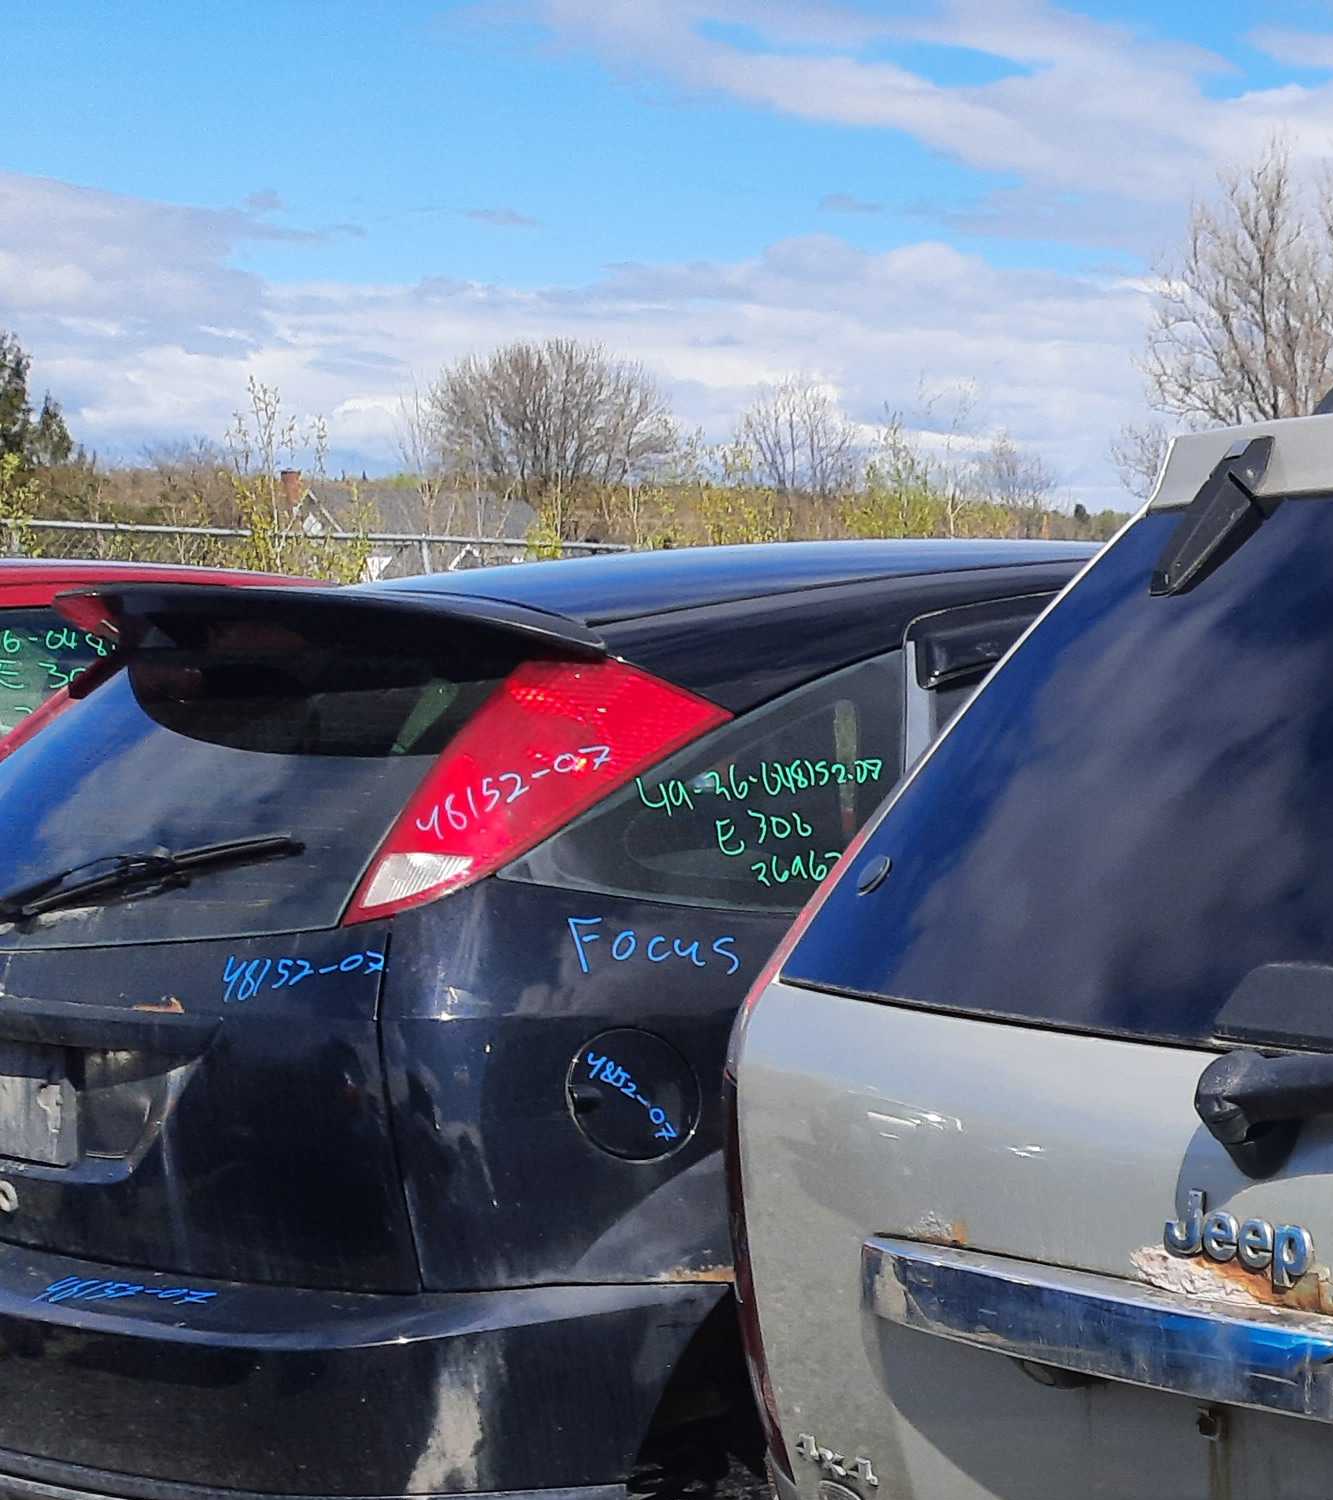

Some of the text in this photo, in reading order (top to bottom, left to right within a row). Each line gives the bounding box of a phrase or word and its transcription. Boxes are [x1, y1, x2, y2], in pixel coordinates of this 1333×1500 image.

[416, 746, 611, 840] 48152-07
[715, 818, 745, 856] E
[223, 950, 385, 1002] 48152-07
[1164, 1188, 1313, 1292] Jeep
